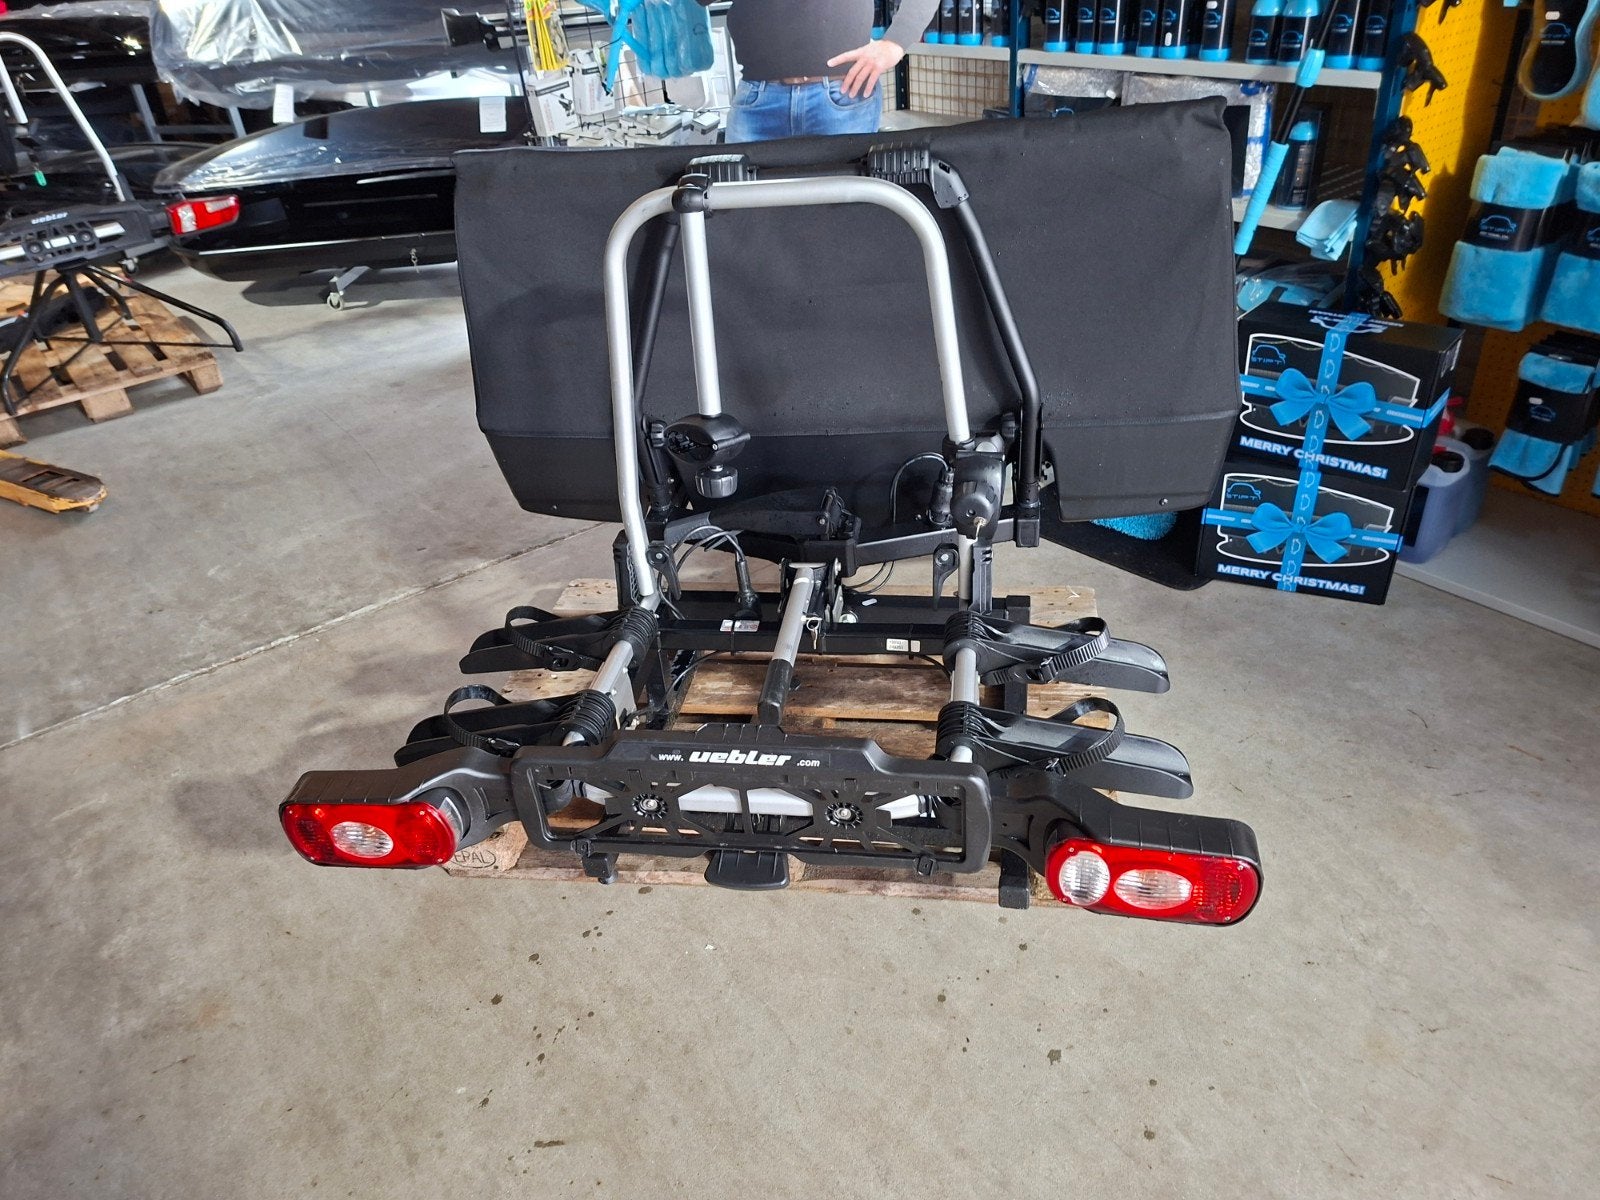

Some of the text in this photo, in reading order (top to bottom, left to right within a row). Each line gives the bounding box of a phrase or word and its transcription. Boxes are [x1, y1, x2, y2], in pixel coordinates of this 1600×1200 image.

[1240, 435, 1388, 479] MERRY CHRISTMAS!
[1217, 563, 1366, 595] MERRY CHRISTMAS!
[658, 750, 821, 768] www. uebler .com
[454, 850, 491, 864] EPAL
